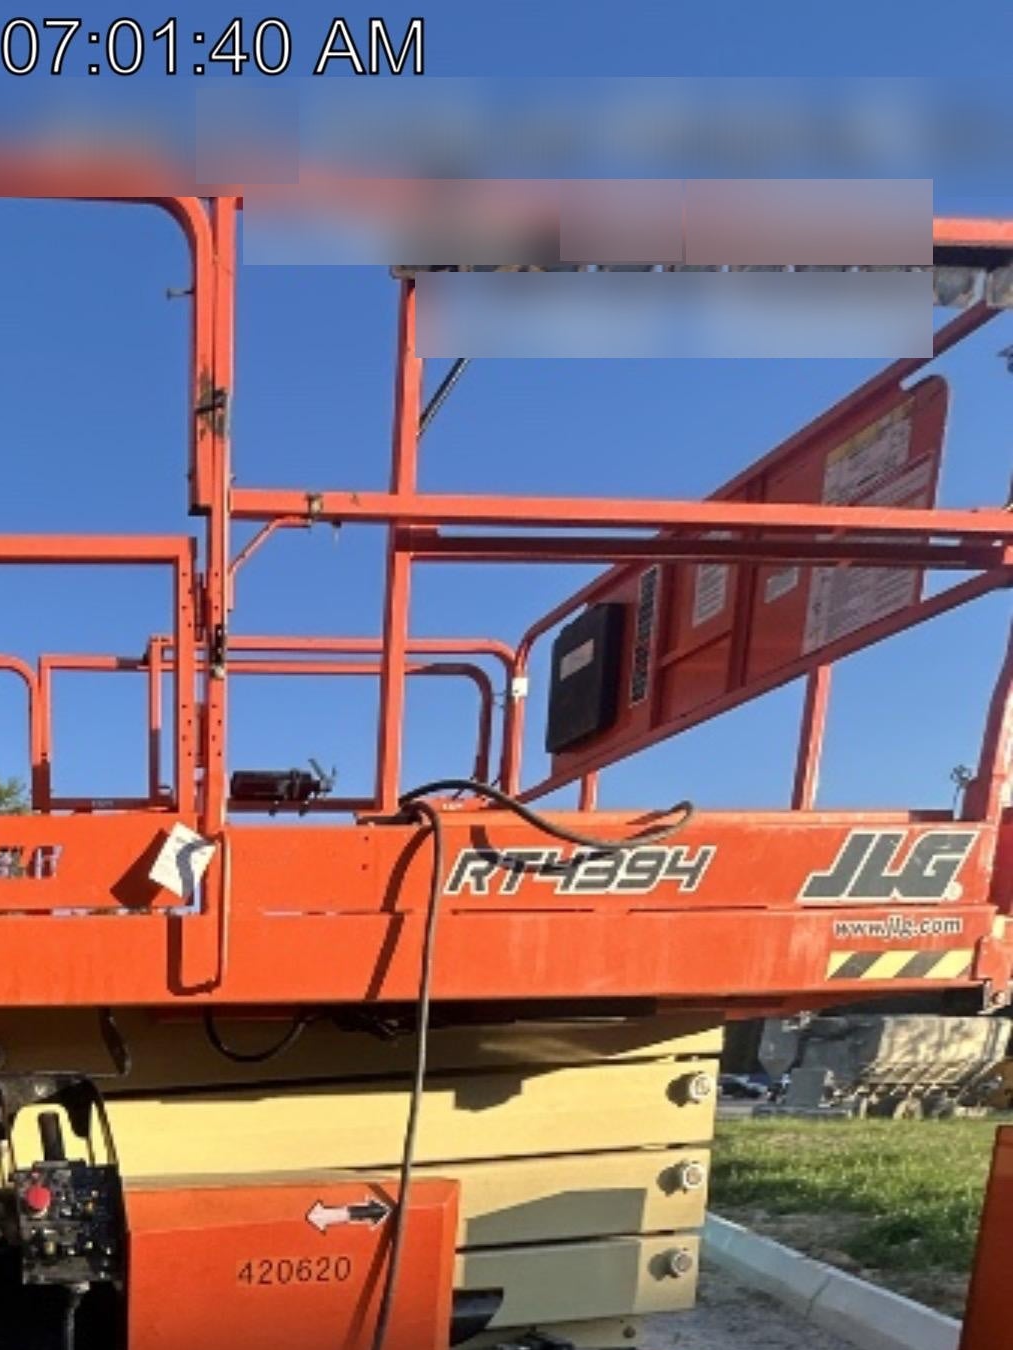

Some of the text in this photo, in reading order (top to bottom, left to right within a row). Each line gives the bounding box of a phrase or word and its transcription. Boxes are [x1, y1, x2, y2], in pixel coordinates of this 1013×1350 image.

[445, 845, 717, 895] RT4394
[797, 829, 979, 903] JLG
[835, 915, 962, 938] www.jlg.com
[238, 1256, 351, 1285] 420620
